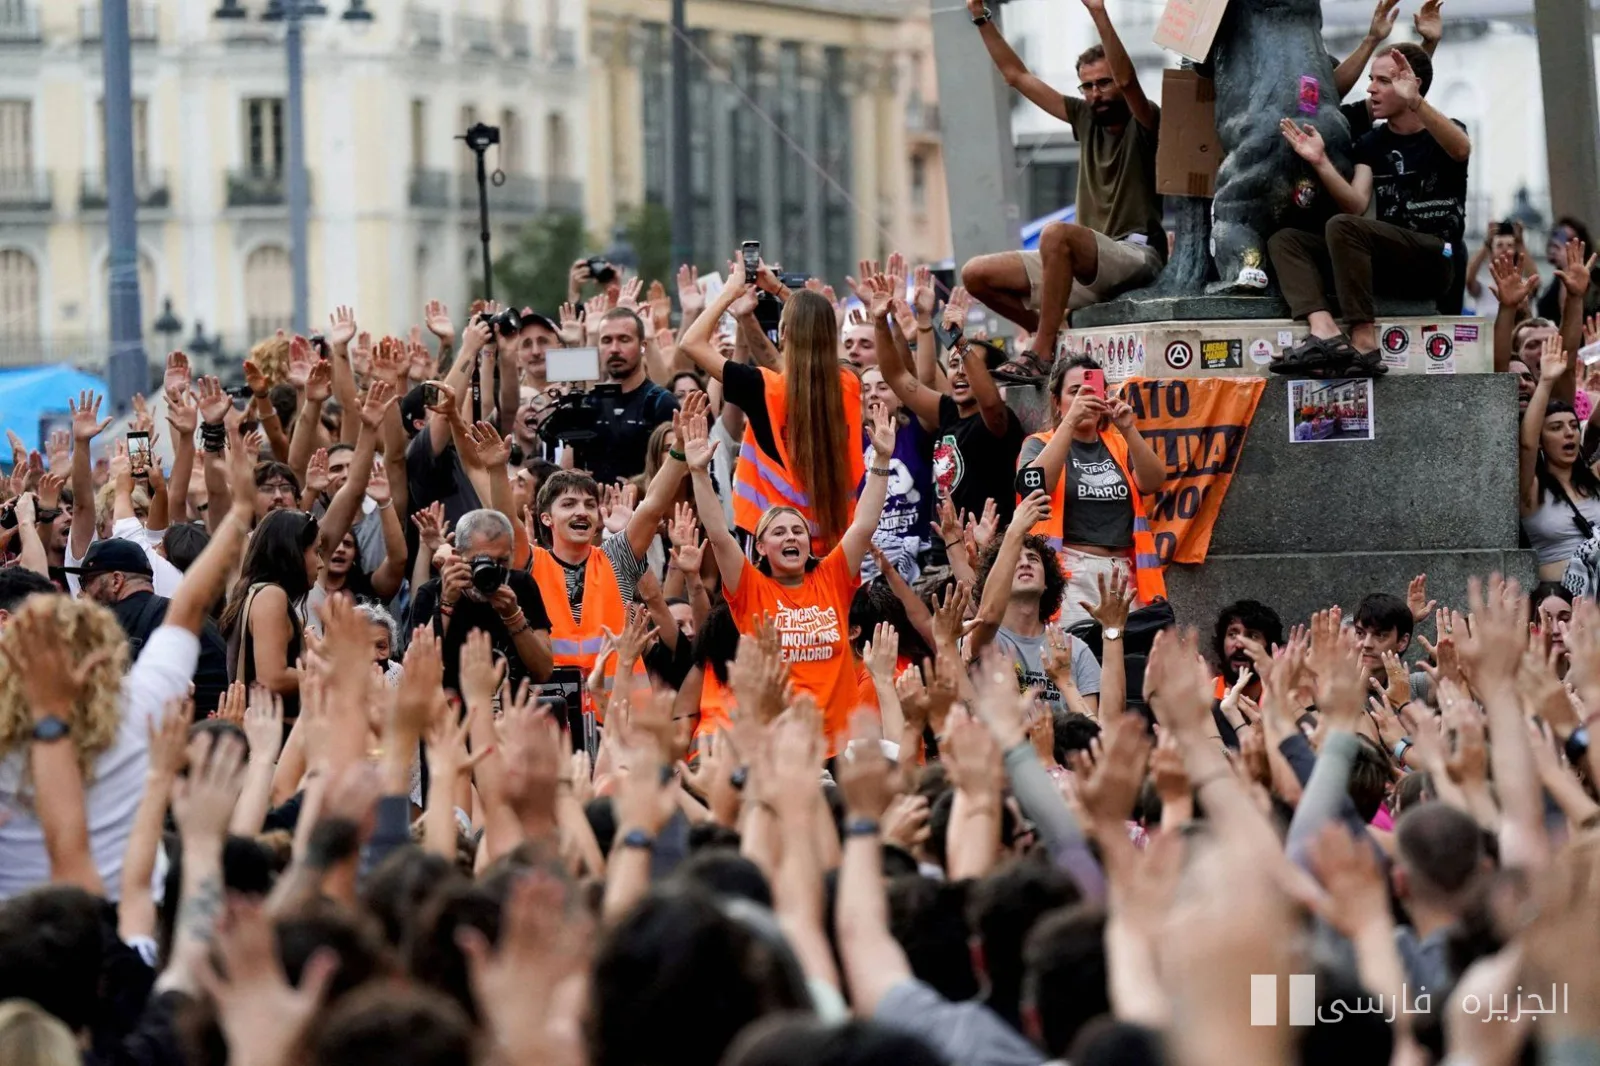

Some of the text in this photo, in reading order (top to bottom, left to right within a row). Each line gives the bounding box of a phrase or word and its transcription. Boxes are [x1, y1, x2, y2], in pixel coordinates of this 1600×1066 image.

[1120, 380, 1190, 419] ATO
[1073, 459, 1116, 474] HCIENDO
[1078, 485, 1128, 499] BARRIO
[788, 646, 833, 662] MADRID
